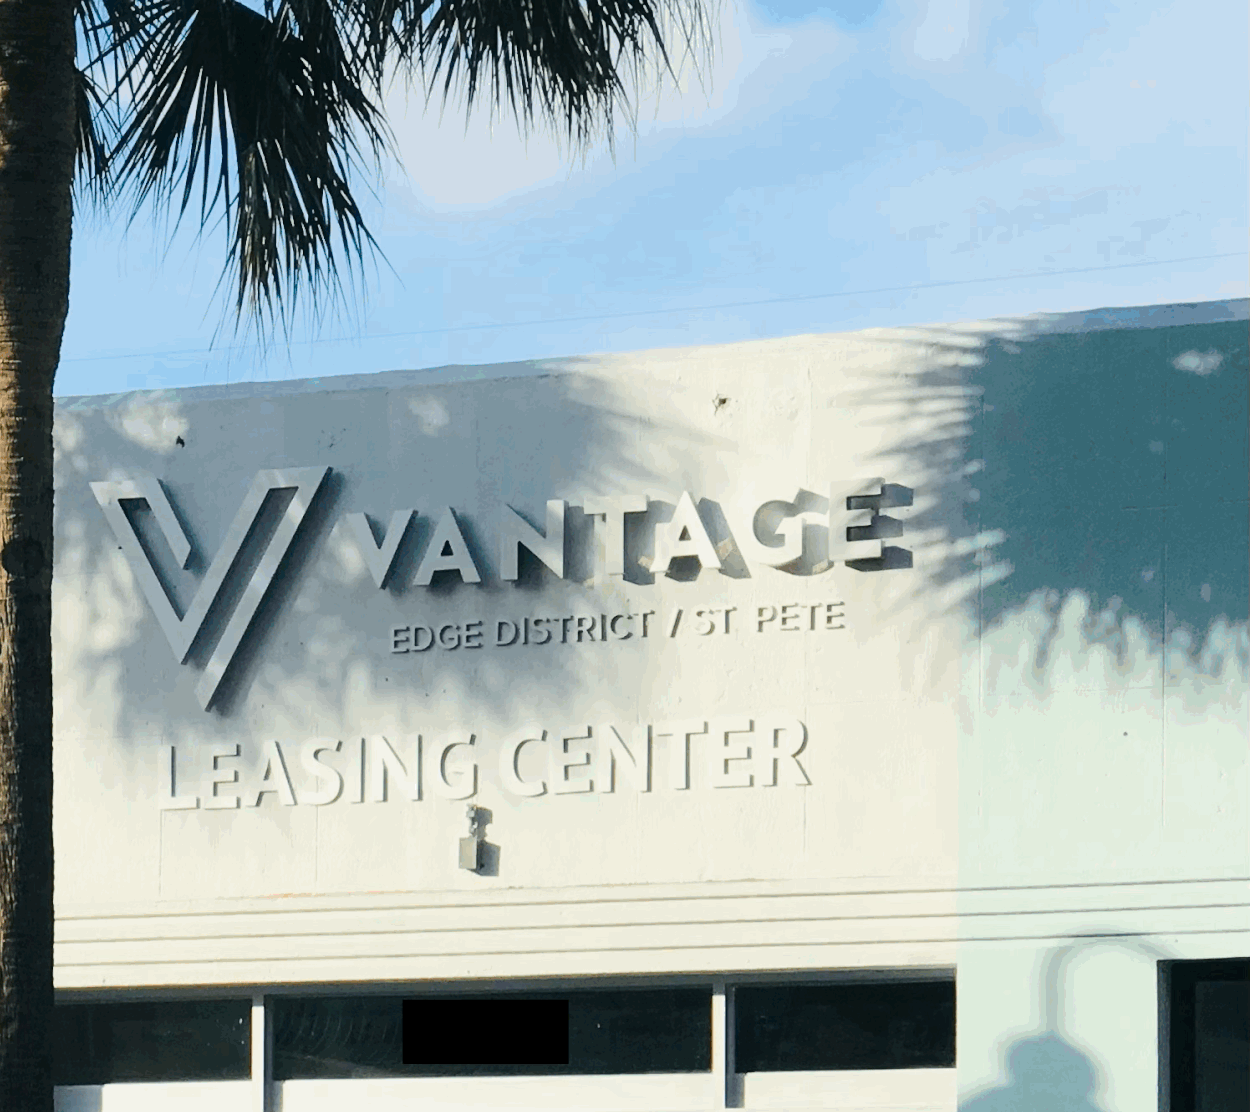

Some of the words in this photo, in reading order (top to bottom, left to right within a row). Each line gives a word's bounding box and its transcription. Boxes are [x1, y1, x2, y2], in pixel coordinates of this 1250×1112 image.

[348, 477, 895, 588] VANTAGE
[390, 620, 484, 653] EDGE
[495, 610, 655, 648] DISTRICT
[756, 601, 846, 633] PETE
[159, 733, 479, 812] LEASING
[498, 719, 814, 798] CENTER
